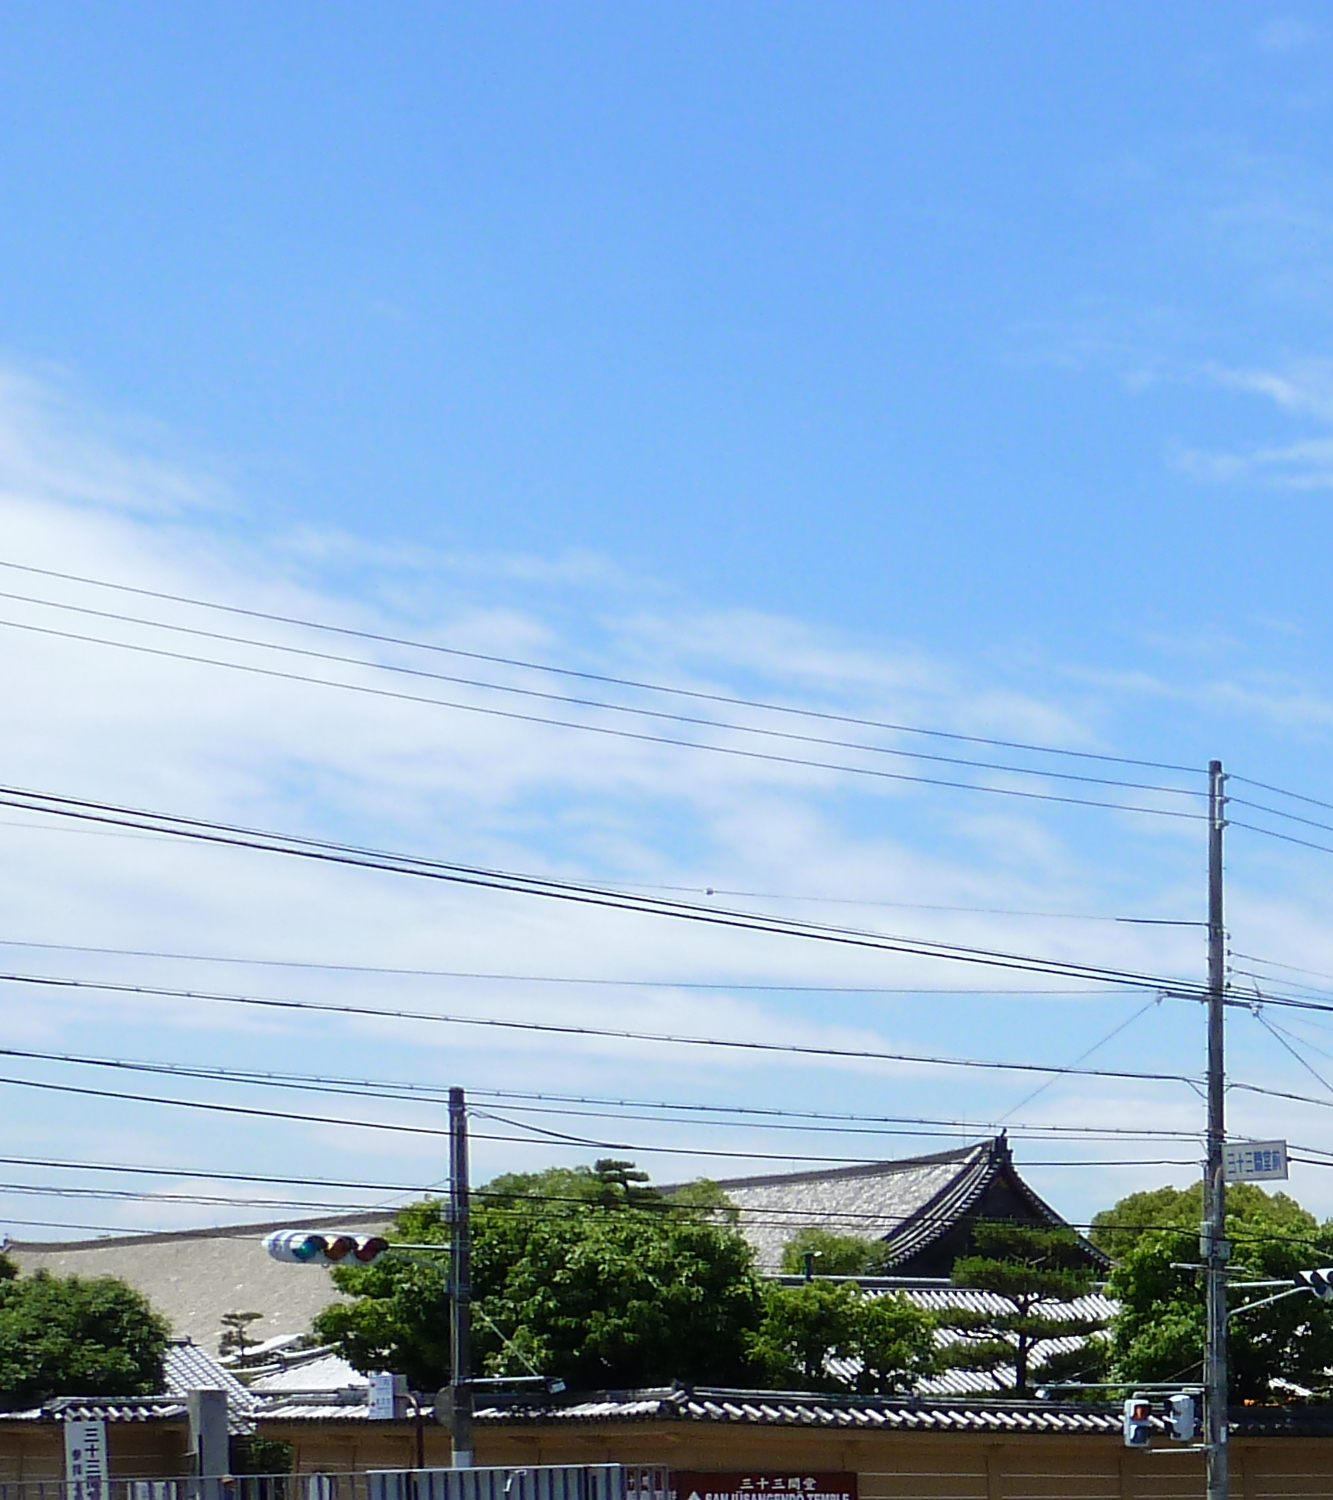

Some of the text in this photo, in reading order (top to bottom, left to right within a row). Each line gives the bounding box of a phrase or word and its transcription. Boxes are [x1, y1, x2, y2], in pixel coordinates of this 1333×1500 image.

[739, 1477, 817, 1490] 三十三間堂
